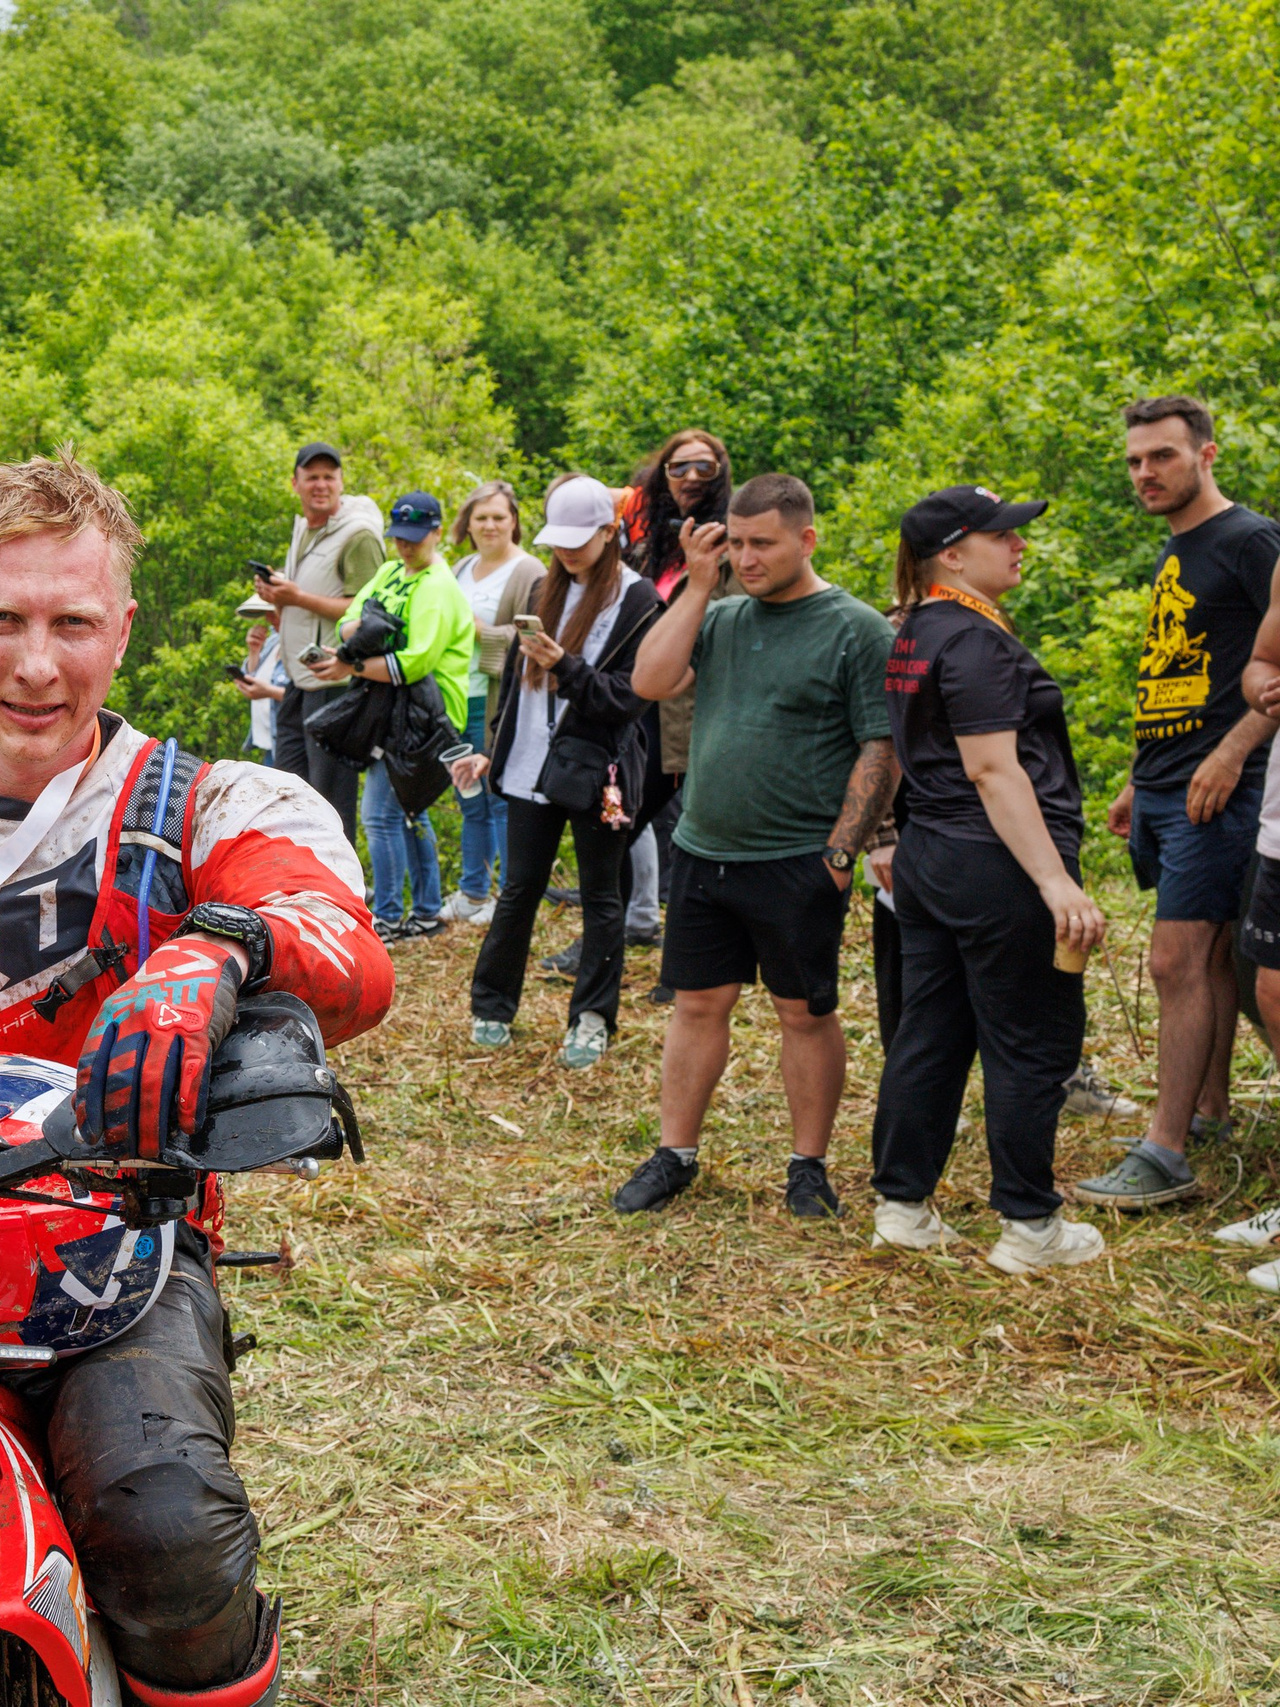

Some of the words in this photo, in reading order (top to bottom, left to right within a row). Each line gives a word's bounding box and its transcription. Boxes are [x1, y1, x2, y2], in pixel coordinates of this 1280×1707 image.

[1156, 680, 1192, 690] OPEN
[1155, 689, 1174, 697] PIT
[1154, 696, 1190, 705] RACE
